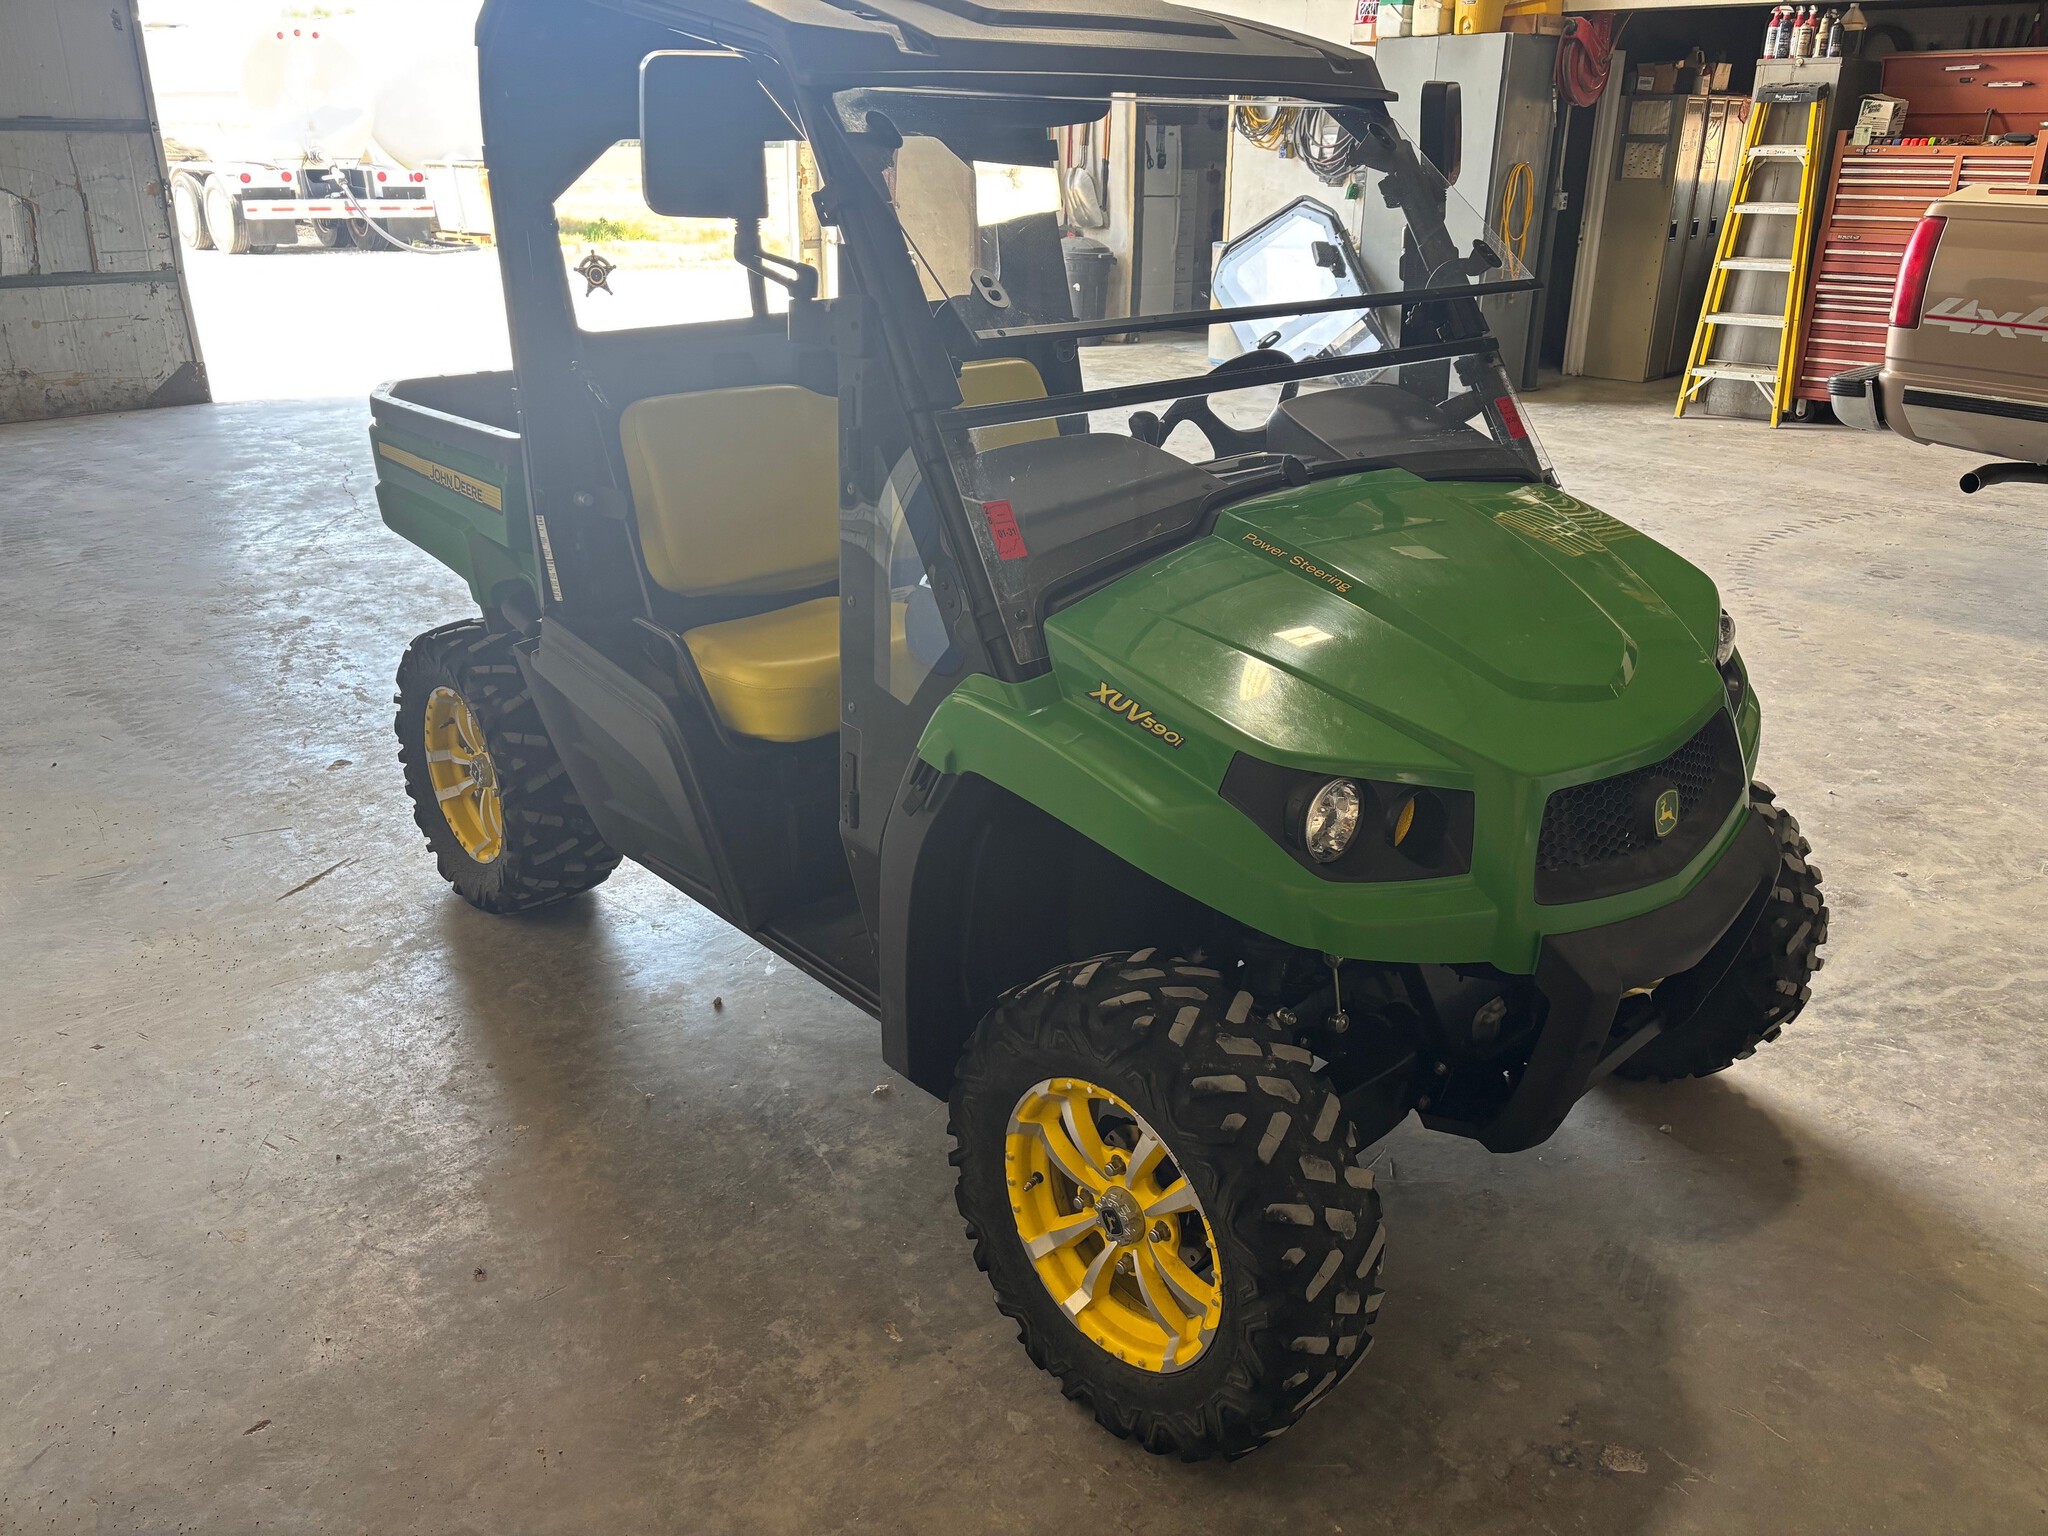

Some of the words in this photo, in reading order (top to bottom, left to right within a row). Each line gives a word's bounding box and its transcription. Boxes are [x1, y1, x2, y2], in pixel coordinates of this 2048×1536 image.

[430, 465, 453, 488] JOHN
[453, 475, 483, 502] DEERE
[1242, 533, 1288, 557] Power
[1289, 556, 1352, 593] Steering
[1087, 681, 1185, 748] XUV590i
